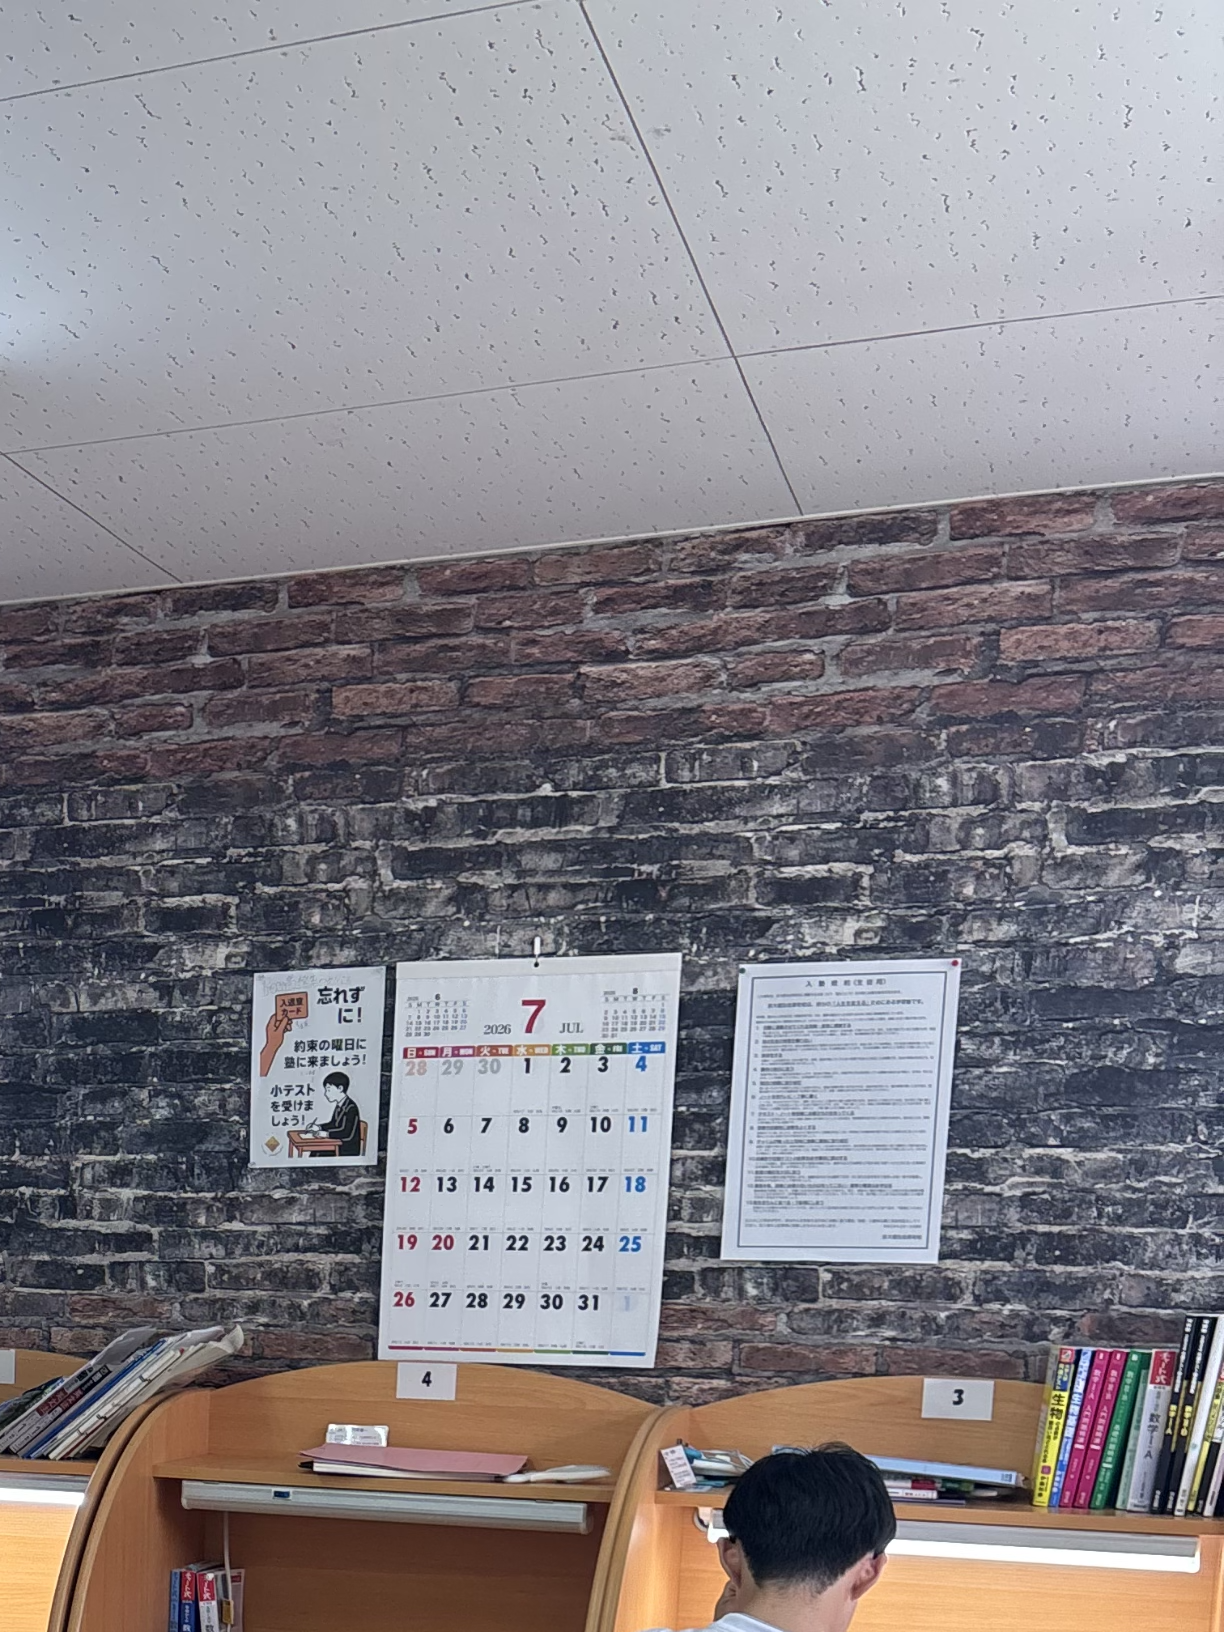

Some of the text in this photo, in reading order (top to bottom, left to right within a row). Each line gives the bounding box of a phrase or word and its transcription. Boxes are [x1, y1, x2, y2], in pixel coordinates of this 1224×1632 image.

[317, 985, 365, 1004] 忘れず
[281, 1008, 302, 1017] カード
[338, 1007, 362, 1024] に!
[522, 1000, 546, 1033] 7
[484, 1024, 511, 1035] 2026
[560, 1023, 583, 1033] JUL
[294, 1038, 367, 1053] 約束の曜日に
[442, 1047, 452, 1057] 月
[480, 1046, 490, 1056] 火
[516, 1046, 527, 1056] 水
[556, 1045, 566, 1055] 木
[595, 1044, 605, 1054] 金
[631, 1044, 642, 1053] 土
[407, 1049, 416, 1058] 日
[284, 1054, 367, 1069] 塾に来ましょう!
[405, 1056, 647, 1076] 28 29 30 1 2 3 4
[270, 1084, 315, 1097] 小テスト
[270, 1100, 314, 1112] を受けま
[271, 1115, 306, 1126] しょう!
[408, 1116, 647, 1134] 5 6 7 8 9 10 11
[401, 1176, 646, 1192] 12 13 14 15 16 17 18
[398, 1235, 641, 1252] 19 20 21 22 23 24 25
[394, 1292, 414, 1307] 26
[430, 1292, 452, 1307] 27
[466, 1293, 488, 1308] 28
[503, 1293, 525, 1309] 29
[540, 1294, 563, 1309] 30
[578, 1295, 598, 1310] 31
[422, 1371, 431, 1386] 4
[953, 1389, 964, 1405] 3
[1050, 1393, 1065, 1420] 生物
